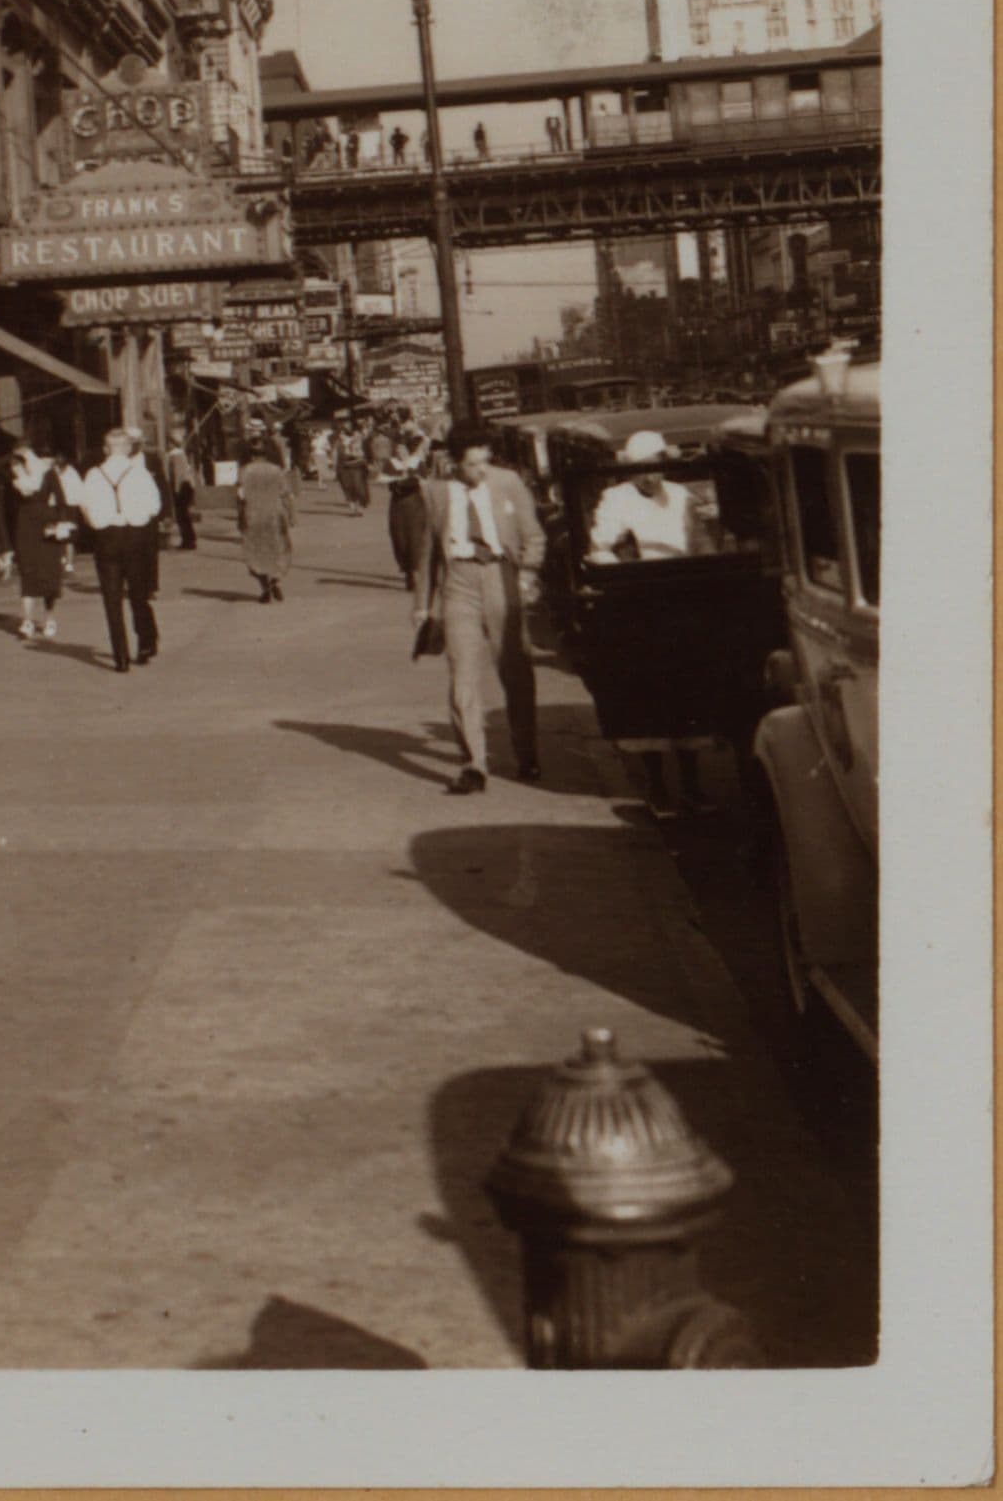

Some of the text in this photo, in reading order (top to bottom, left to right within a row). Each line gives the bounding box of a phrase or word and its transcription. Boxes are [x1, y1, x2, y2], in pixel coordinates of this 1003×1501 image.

[72, 97, 195, 138] CHOP
[10, 227, 248, 268] RESTAURANT
[72, 282, 197, 315] CHOP SUEY
